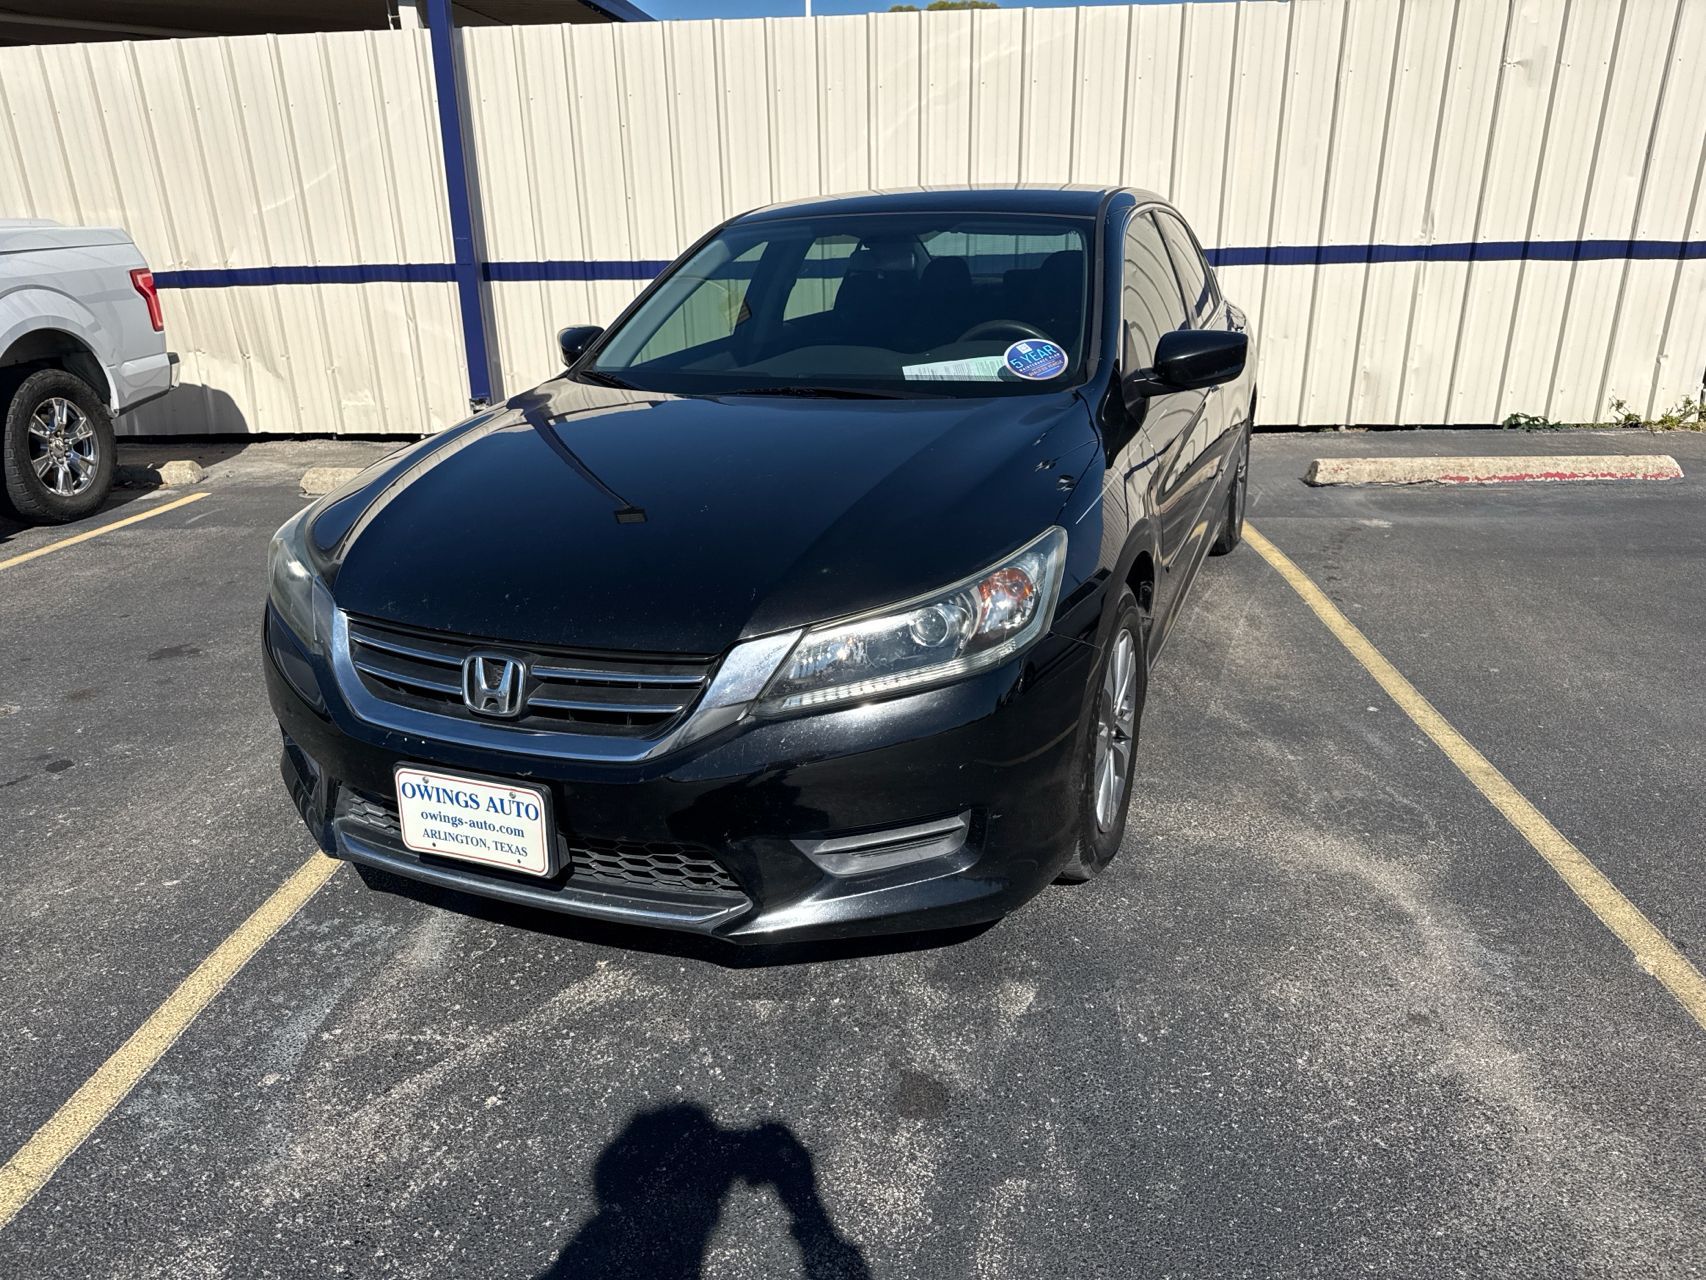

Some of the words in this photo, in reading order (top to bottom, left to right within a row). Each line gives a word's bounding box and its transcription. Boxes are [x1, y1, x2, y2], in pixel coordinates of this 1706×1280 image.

[1009, 358, 1024, 369] 5
[1020, 344, 1057, 364] YEAR
[401, 782, 480, 810] OWINGS
[486, 796, 539, 821] AUTO
[420, 810, 525, 838] owings-auto.com
[422, 828, 491, 851] ARLINGTON,
[491, 840, 528, 857] TEXAS
